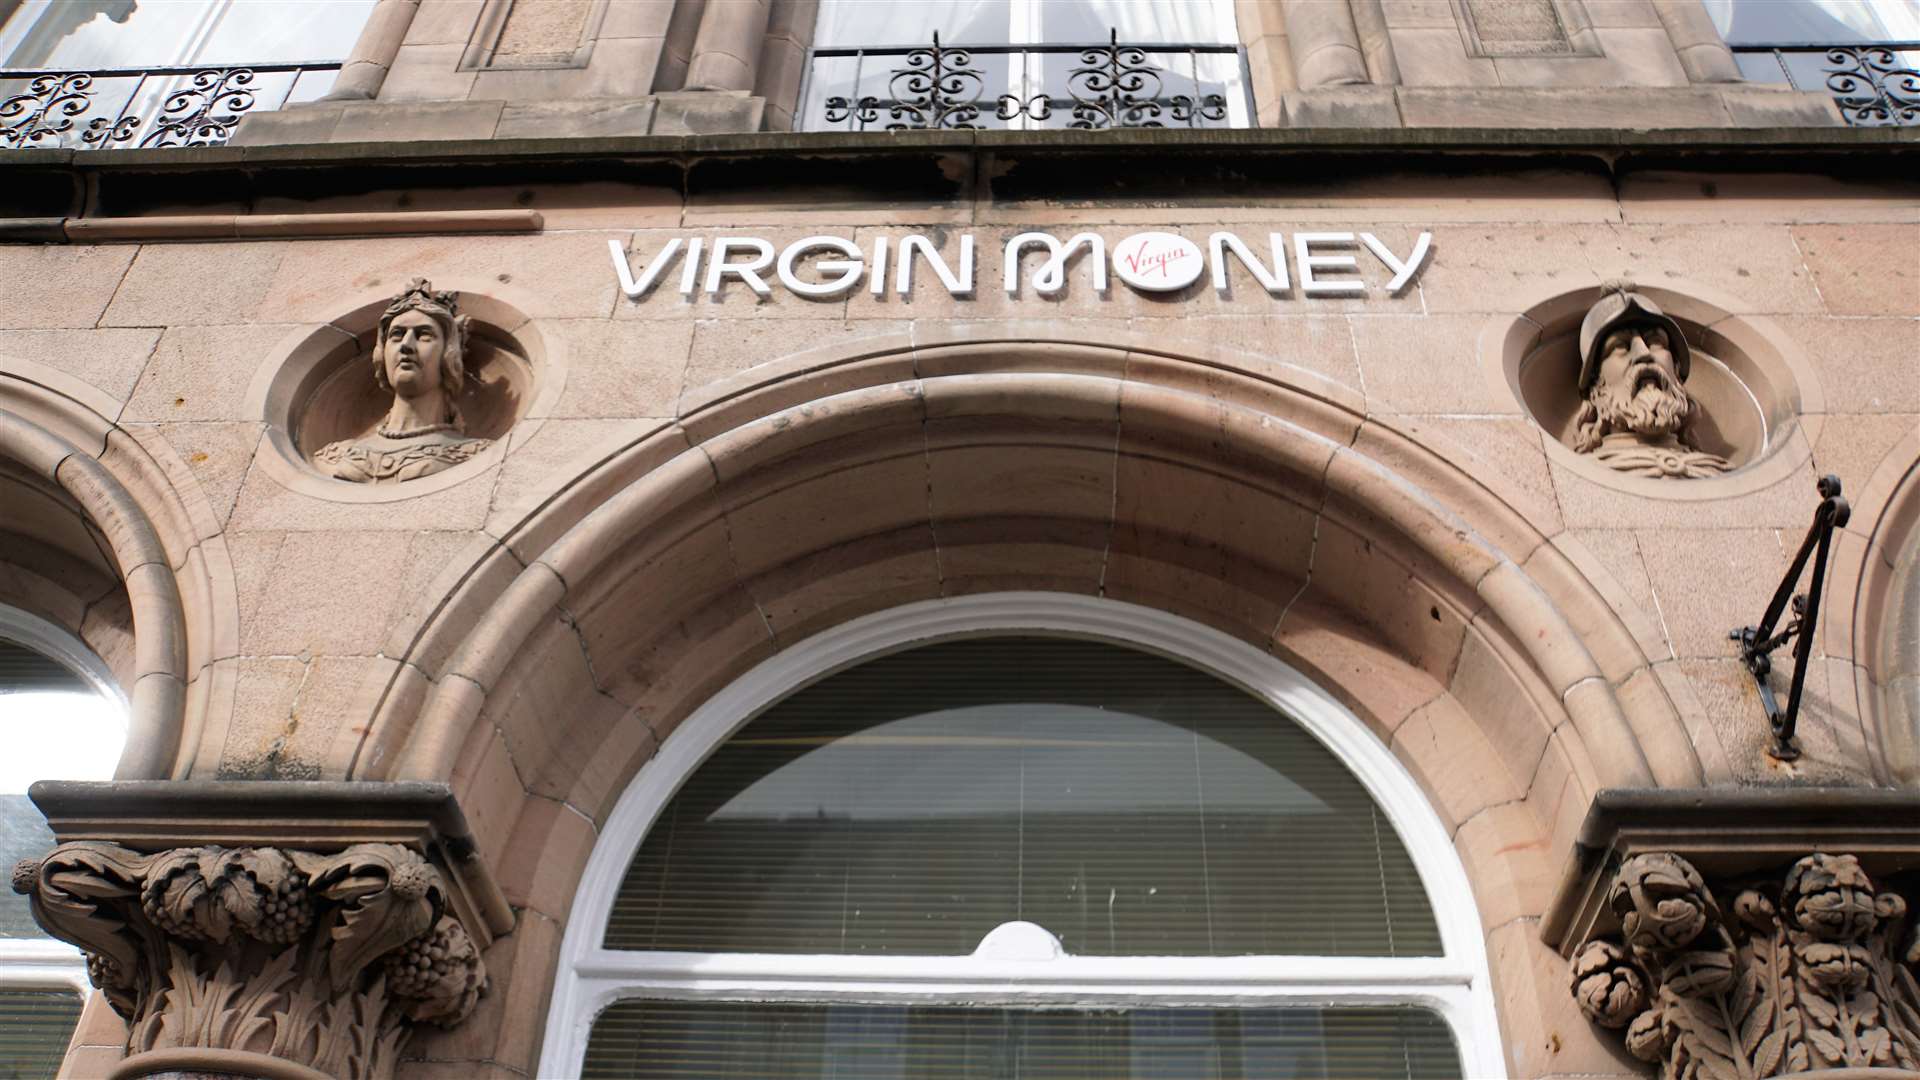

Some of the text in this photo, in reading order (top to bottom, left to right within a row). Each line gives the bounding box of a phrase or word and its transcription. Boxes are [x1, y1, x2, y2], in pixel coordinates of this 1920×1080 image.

[608, 231, 1432, 298] VIRGIN MONEY
[1125, 240, 1189, 278] Virgin
